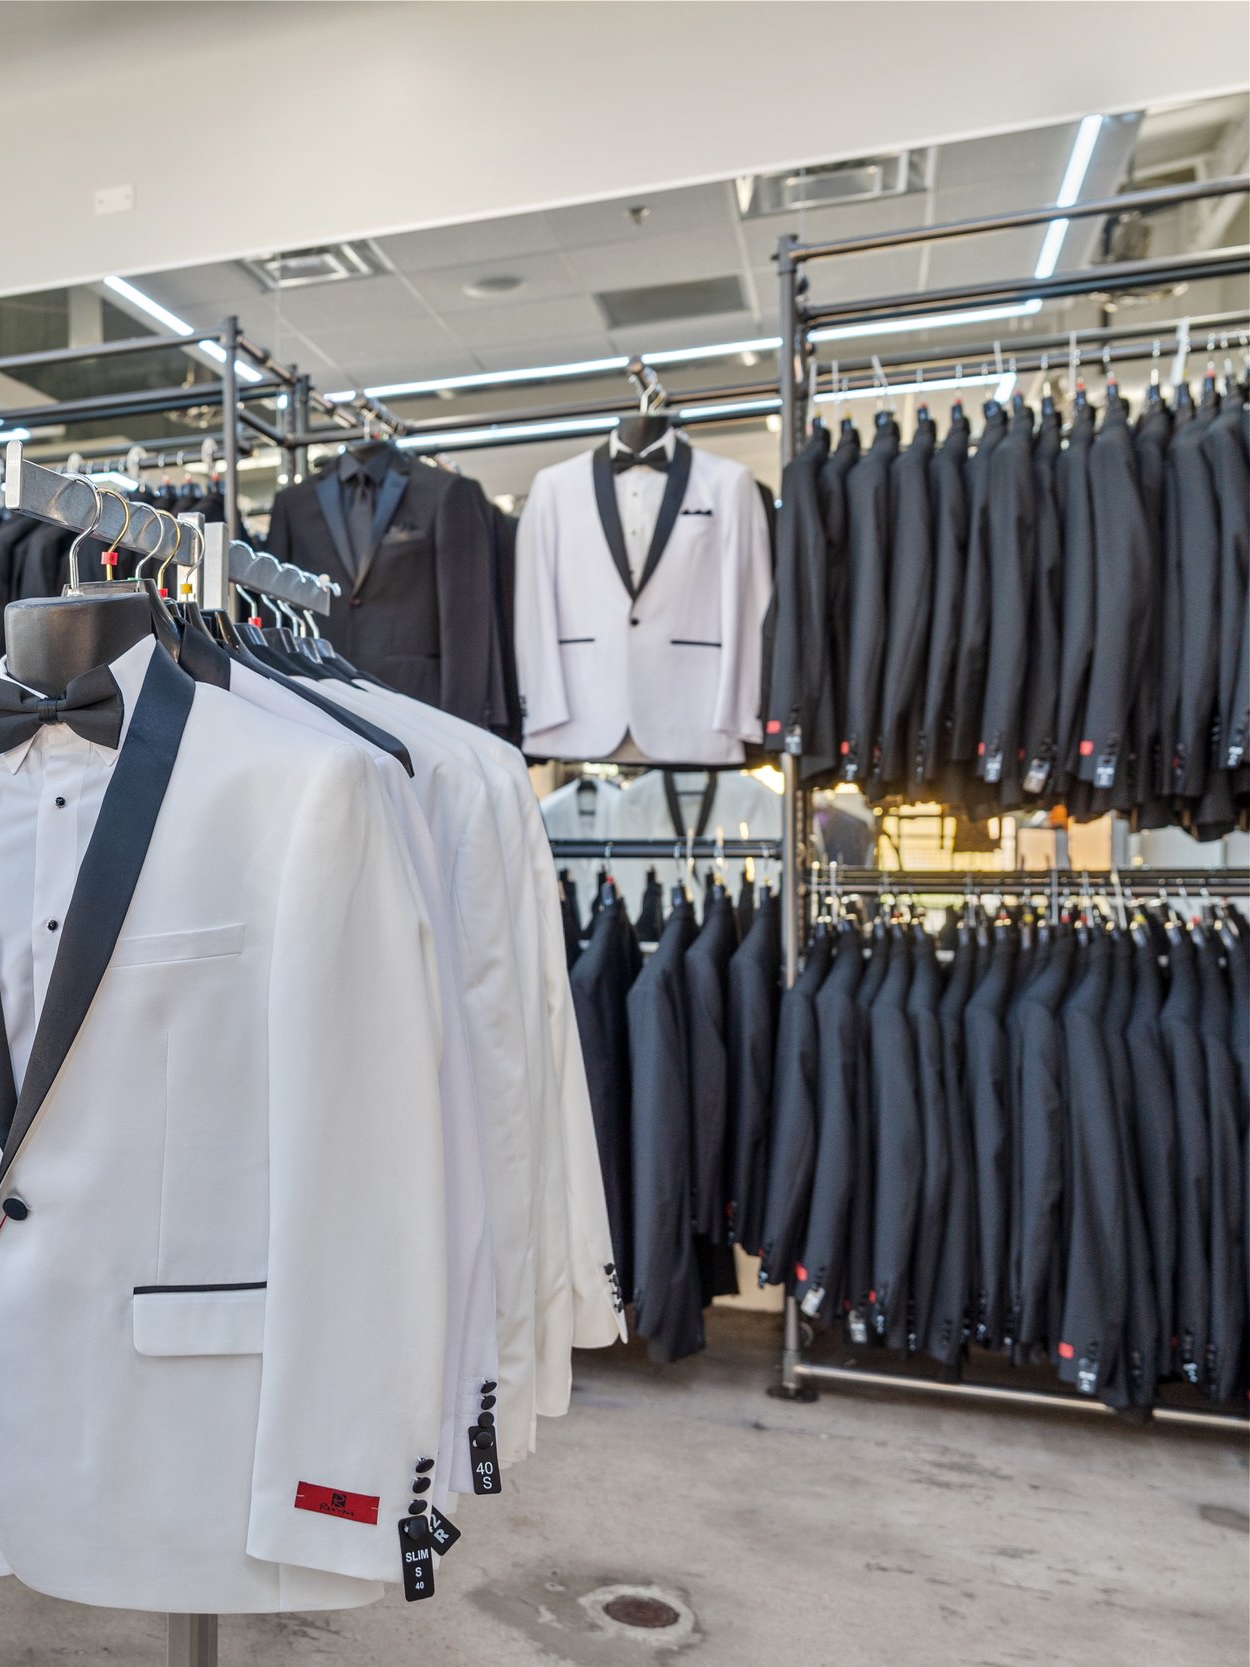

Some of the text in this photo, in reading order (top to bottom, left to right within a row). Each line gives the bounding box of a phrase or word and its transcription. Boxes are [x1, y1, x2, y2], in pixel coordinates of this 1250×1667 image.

[476, 1461, 493, 1475] 40
[483, 1476, 492, 1489] S
[433, 1528, 449, 1544] R
[405, 1548, 429, 1563] SLIM
[415, 1566, 423, 1577] S
[415, 1581, 425, 1590] 40
